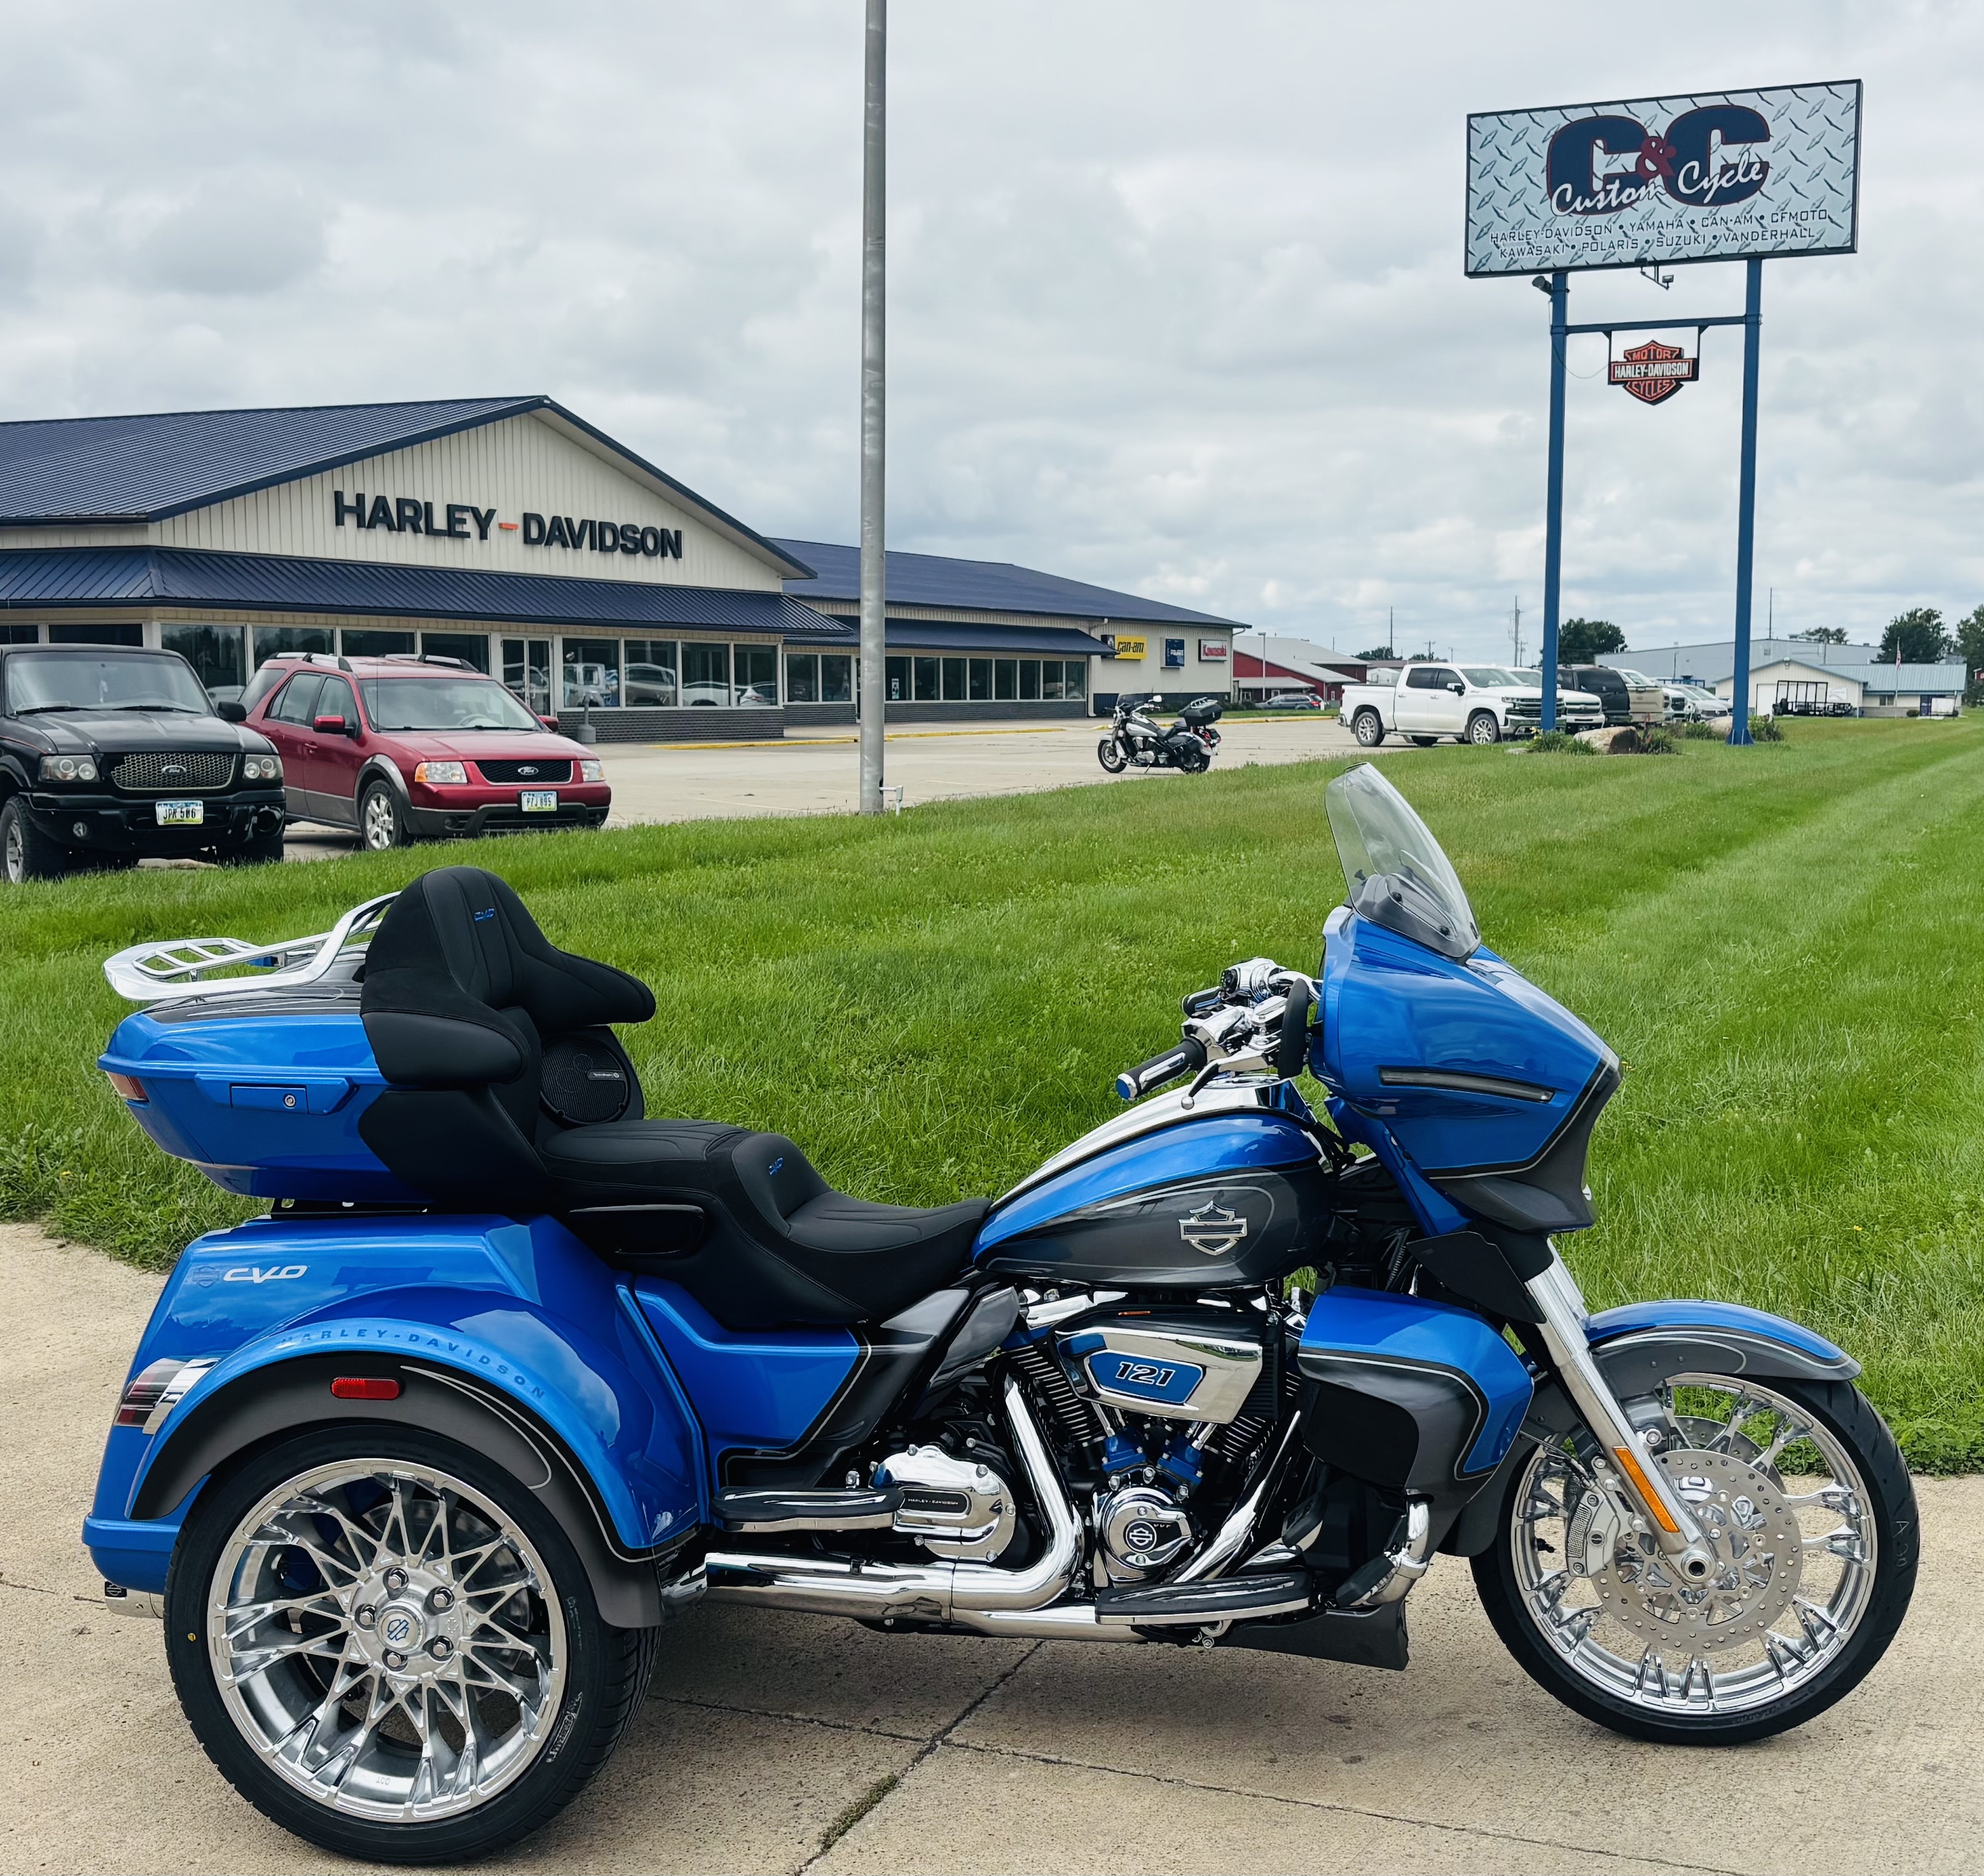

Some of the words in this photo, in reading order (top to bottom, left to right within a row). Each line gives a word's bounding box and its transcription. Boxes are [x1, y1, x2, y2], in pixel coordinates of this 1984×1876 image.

[1546, 104, 1771, 215] C&C
[1550, 173, 1667, 216] Custom
[1678, 150, 1763, 204] Cycle
[1629, 219, 1684, 232] YAMAHA
[1771, 209, 1827, 223] CFMOTO
[1500, 244, 1565, 259] KAWASAKI
[1581, 239, 1639, 252] POLARIS
[1656, 234, 1706, 247] SUZUKI
[1723, 227, 1815, 243] VANDERHALL
[1632, 346, 1673, 360] MOTOR
[1614, 362, 1689, 378] HARLEY-DAVIDSON
[1632, 380, 1671, 398] CYCLES
[1117, 641, 1144, 653] can-am
[223, 1265, 308, 1284] CVO
[1115, 1361, 1176, 1387] 121
